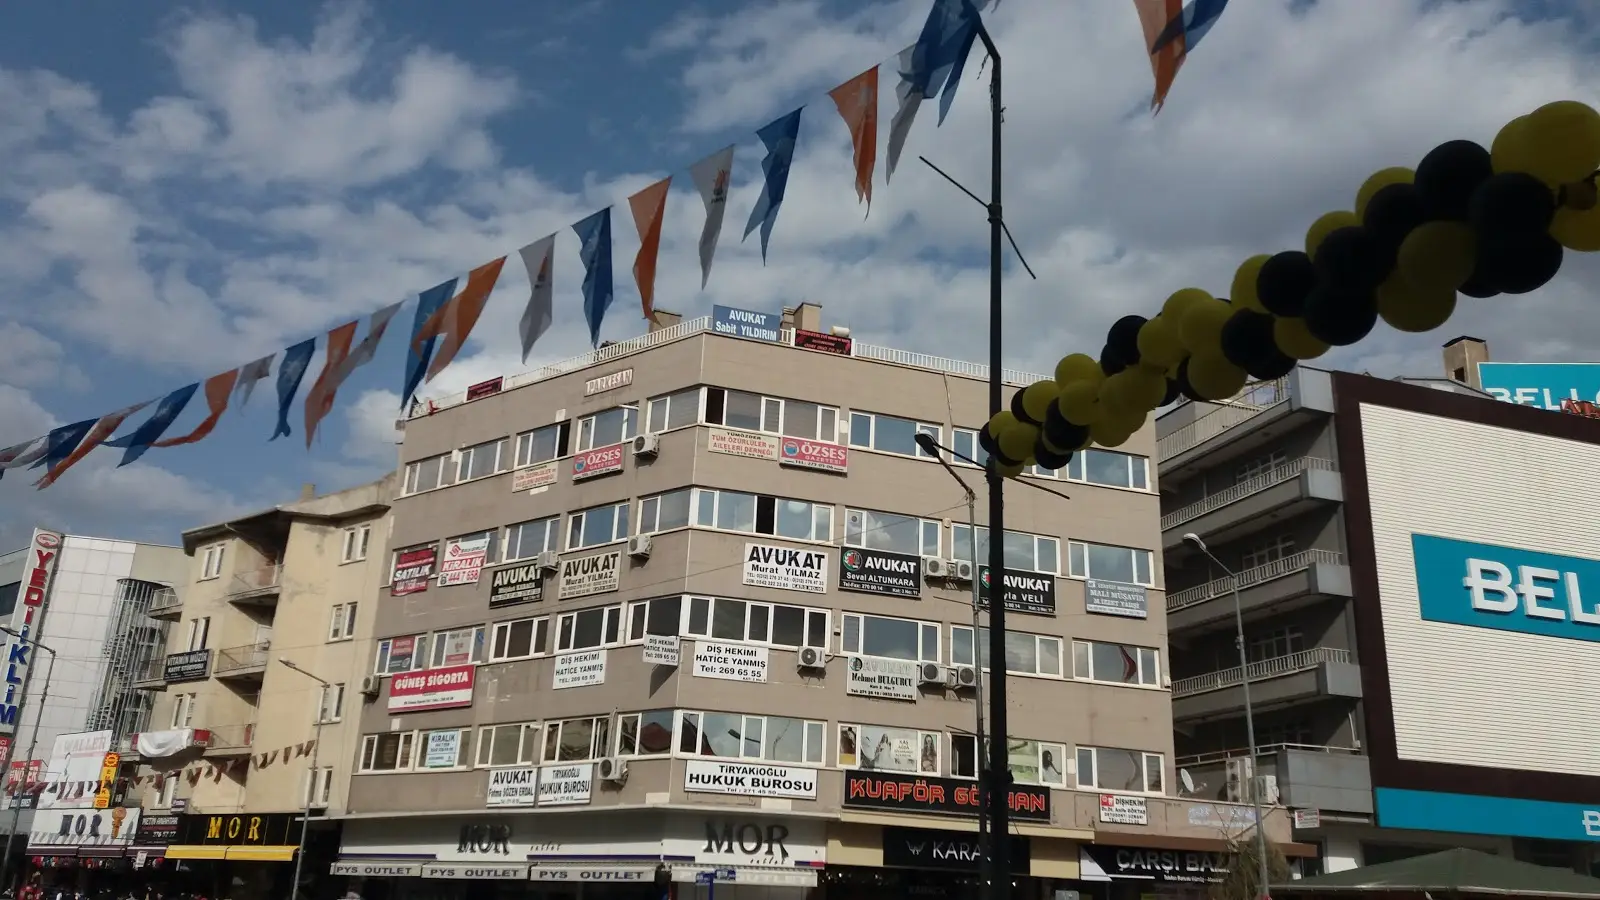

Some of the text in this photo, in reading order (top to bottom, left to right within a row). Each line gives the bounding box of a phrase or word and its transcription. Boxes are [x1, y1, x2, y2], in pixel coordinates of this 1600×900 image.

[728, 310, 766, 326] AVUKAT
[715, 320, 777, 342] Sabit YILDIRIM
[1485, 387, 1600, 410] BELL
[712, 434, 727, 442] TÜM
[587, 448, 621, 465] ÖZSES
[801, 442, 846, 460] ÖZSES
[442, 557, 482, 572] KİRALIK
[563, 553, 618, 578] AVUKAT
[748, 546, 825, 570] AVUKAT
[864, 556, 916, 574] AVUKAT
[394, 564, 432, 582] SATILIK
[493, 564, 540, 587] AVUKAT
[566, 570, 614, 586] Murat YILMAZ
[752, 564, 821, 580] Murat YILMAZ
[846, 571, 914, 587] Seval ALTUNKARA
[1004, 574, 1051, 592] AVUKAT
[1004, 592, 1043, 604] yla VELİ
[1090, 588, 1145, 602] MALİ MÜŞAVİR
[1463, 557, 1600, 626] BEL
[649, 638, 658, 646] DİŞ
[560, 652, 600, 665] DİŞ HEKİMİ
[660, 647, 678, 655] YANMIŞ
[706, 645, 757, 657] DİŞ HEKİMİ
[696, 654, 766, 668] HATİCE YANMIŞ
[556, 664, 604, 676] HATİCE YANMIŞ
[700, 664, 762, 678] Tel: 269 65 55
[852, 672, 876, 683] Mehmet
[394, 671, 468, 690] GÜNEŞ SİGORTA
[430, 734, 456, 743] KİRALIK
[493, 770, 532, 785] AVUKAT
[719, 765, 787, 778] TİRYAKİOĞLU
[540, 780, 590, 795] HUKUK BÜROSU
[689, 773, 813, 792] HUKUK BÜROSU
[850, 776, 1045, 813] KUAFÖR GÖAN
[58, 814, 102, 837] MOR
[207, 816, 262, 841] MOR
[456, 824, 512, 856] MOR
[702, 820, 790, 858] MOR
[933, 840, 992, 862] KARA
[750, 856, 787, 866] outlet
[1116, 850, 1230, 874] ÇARŞI BAZ
[336, 866, 412, 875] PYS OUTLET
[430, 868, 520, 878] PYS OUTLET
[538, 870, 644, 880] PYS OUTLET
